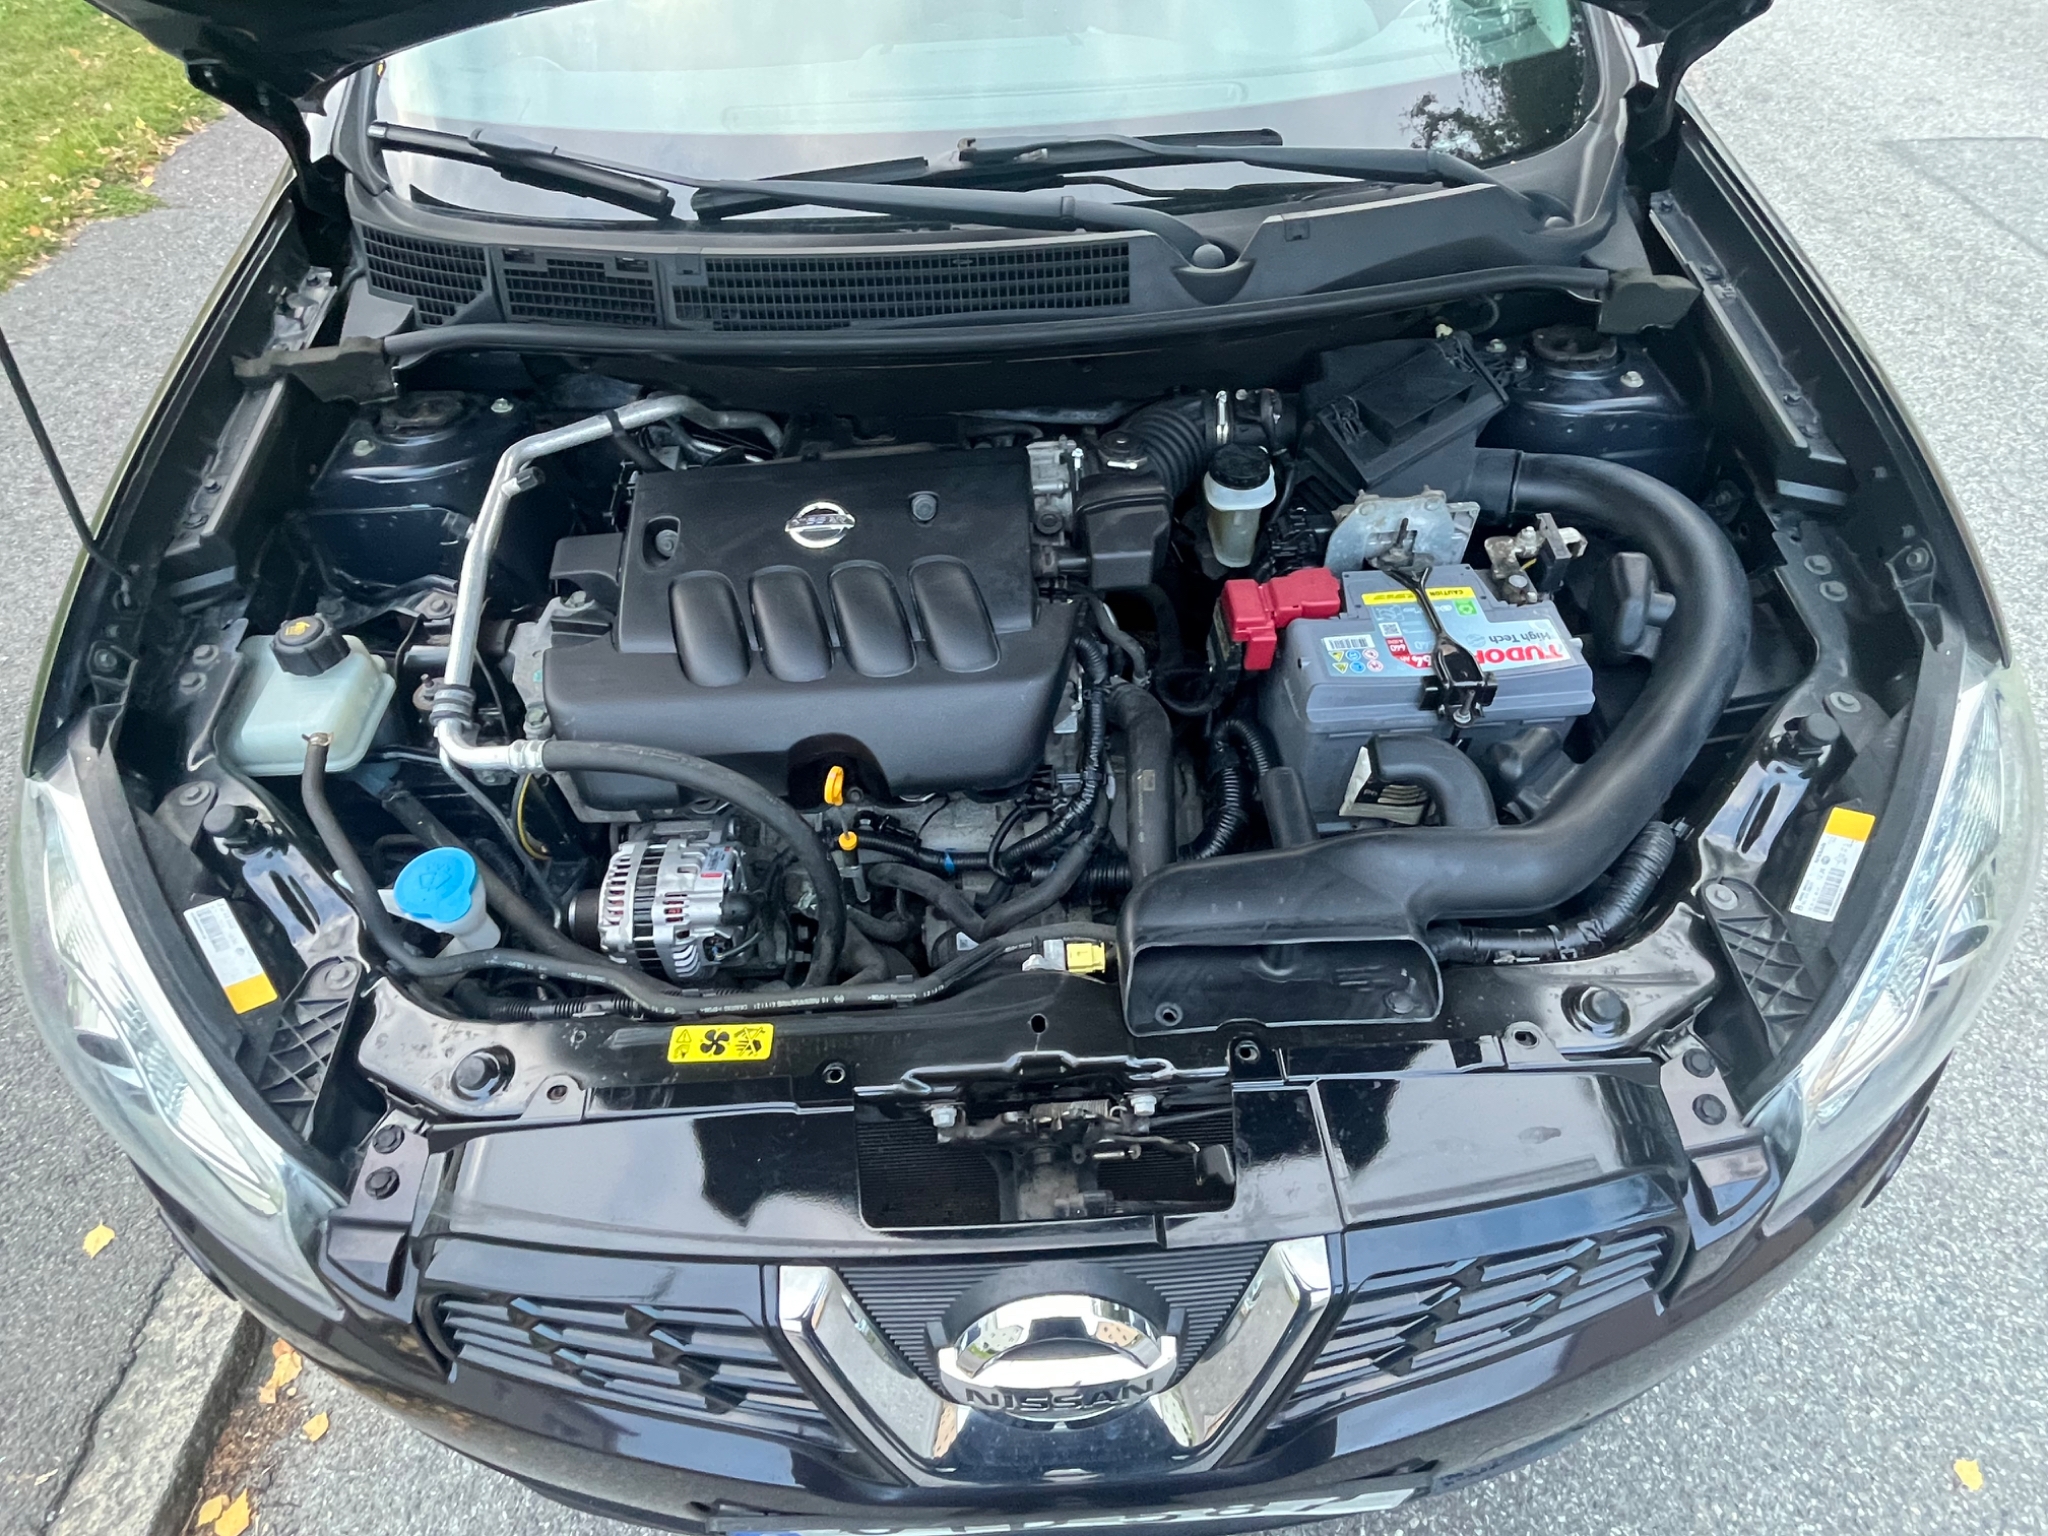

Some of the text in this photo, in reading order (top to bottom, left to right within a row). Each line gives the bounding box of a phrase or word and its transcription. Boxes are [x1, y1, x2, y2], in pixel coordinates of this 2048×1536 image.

[1429, 589, 1464, 597] CAUTION
[1489, 632, 1551, 644] High Tech
[965, 1379, 1154, 1413] NISSAN
